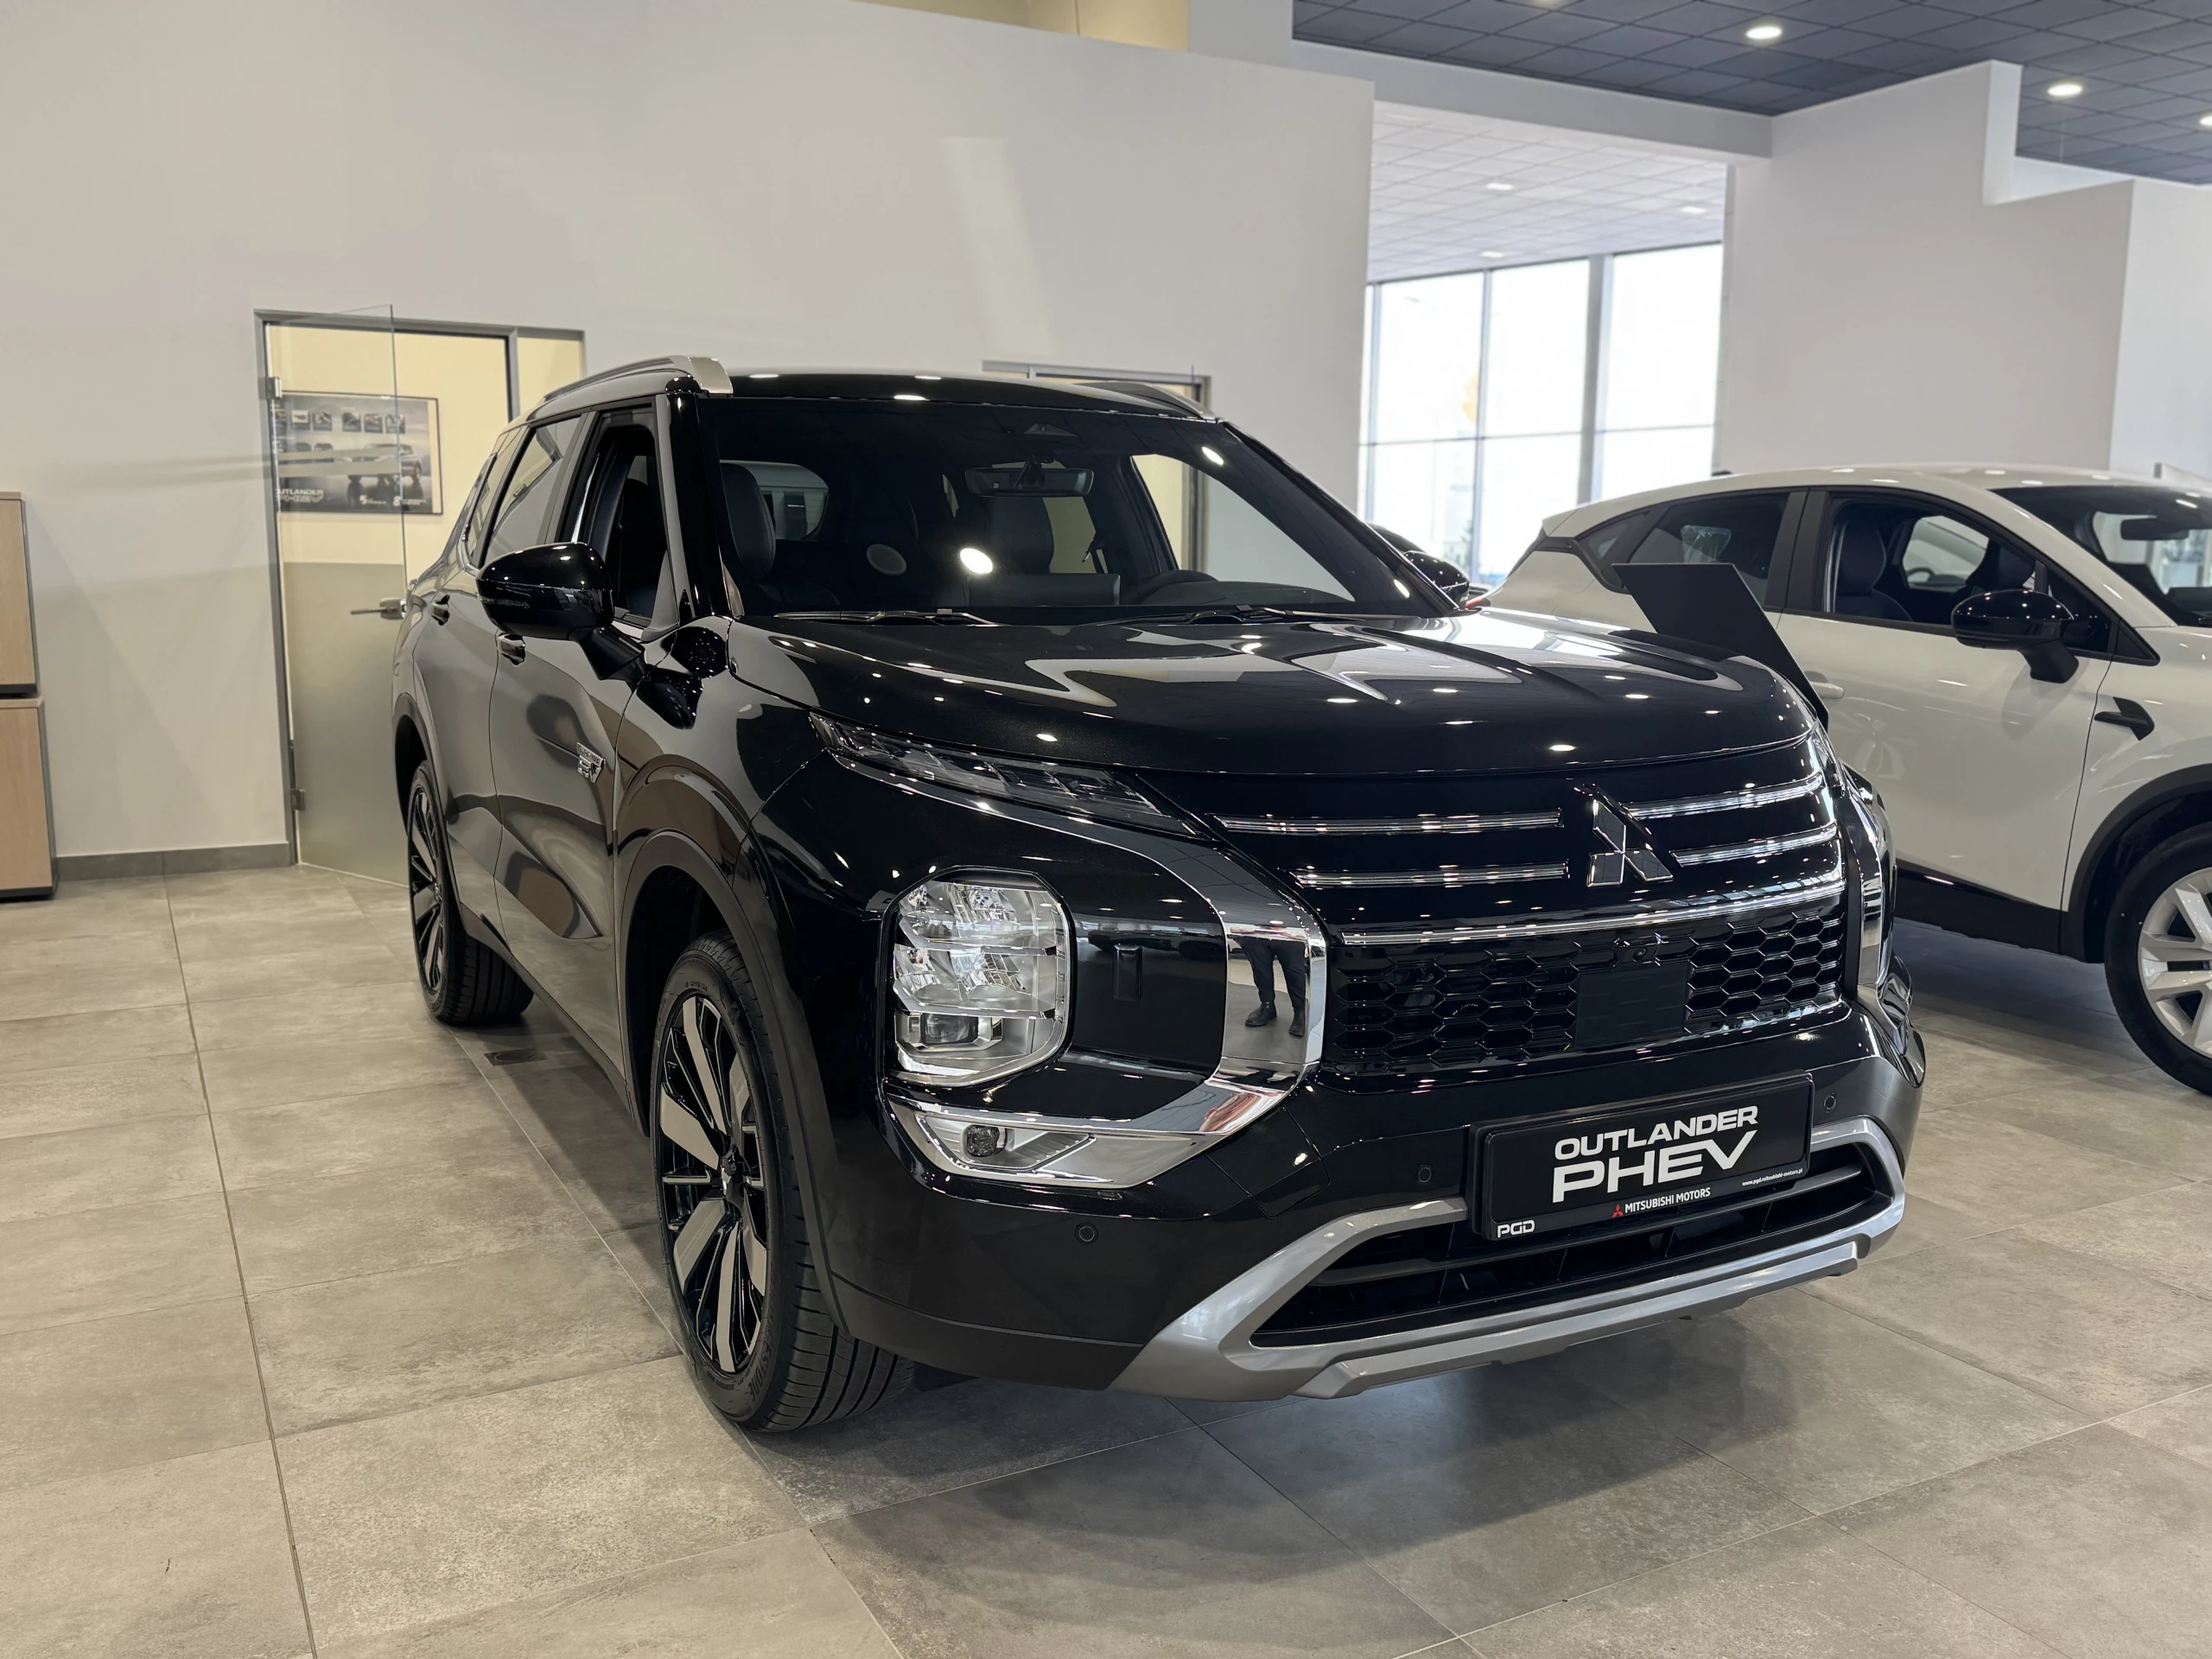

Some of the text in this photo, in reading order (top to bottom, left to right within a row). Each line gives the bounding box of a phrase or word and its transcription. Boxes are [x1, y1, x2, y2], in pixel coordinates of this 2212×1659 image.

[1554, 1105, 1758, 1160] OUTLANDER
[1552, 1129, 1758, 1204] PHEV
[1624, 1186, 1711, 1214] MITSUBISHI MOTORS
[1497, 1219, 1535, 1238] PGD
